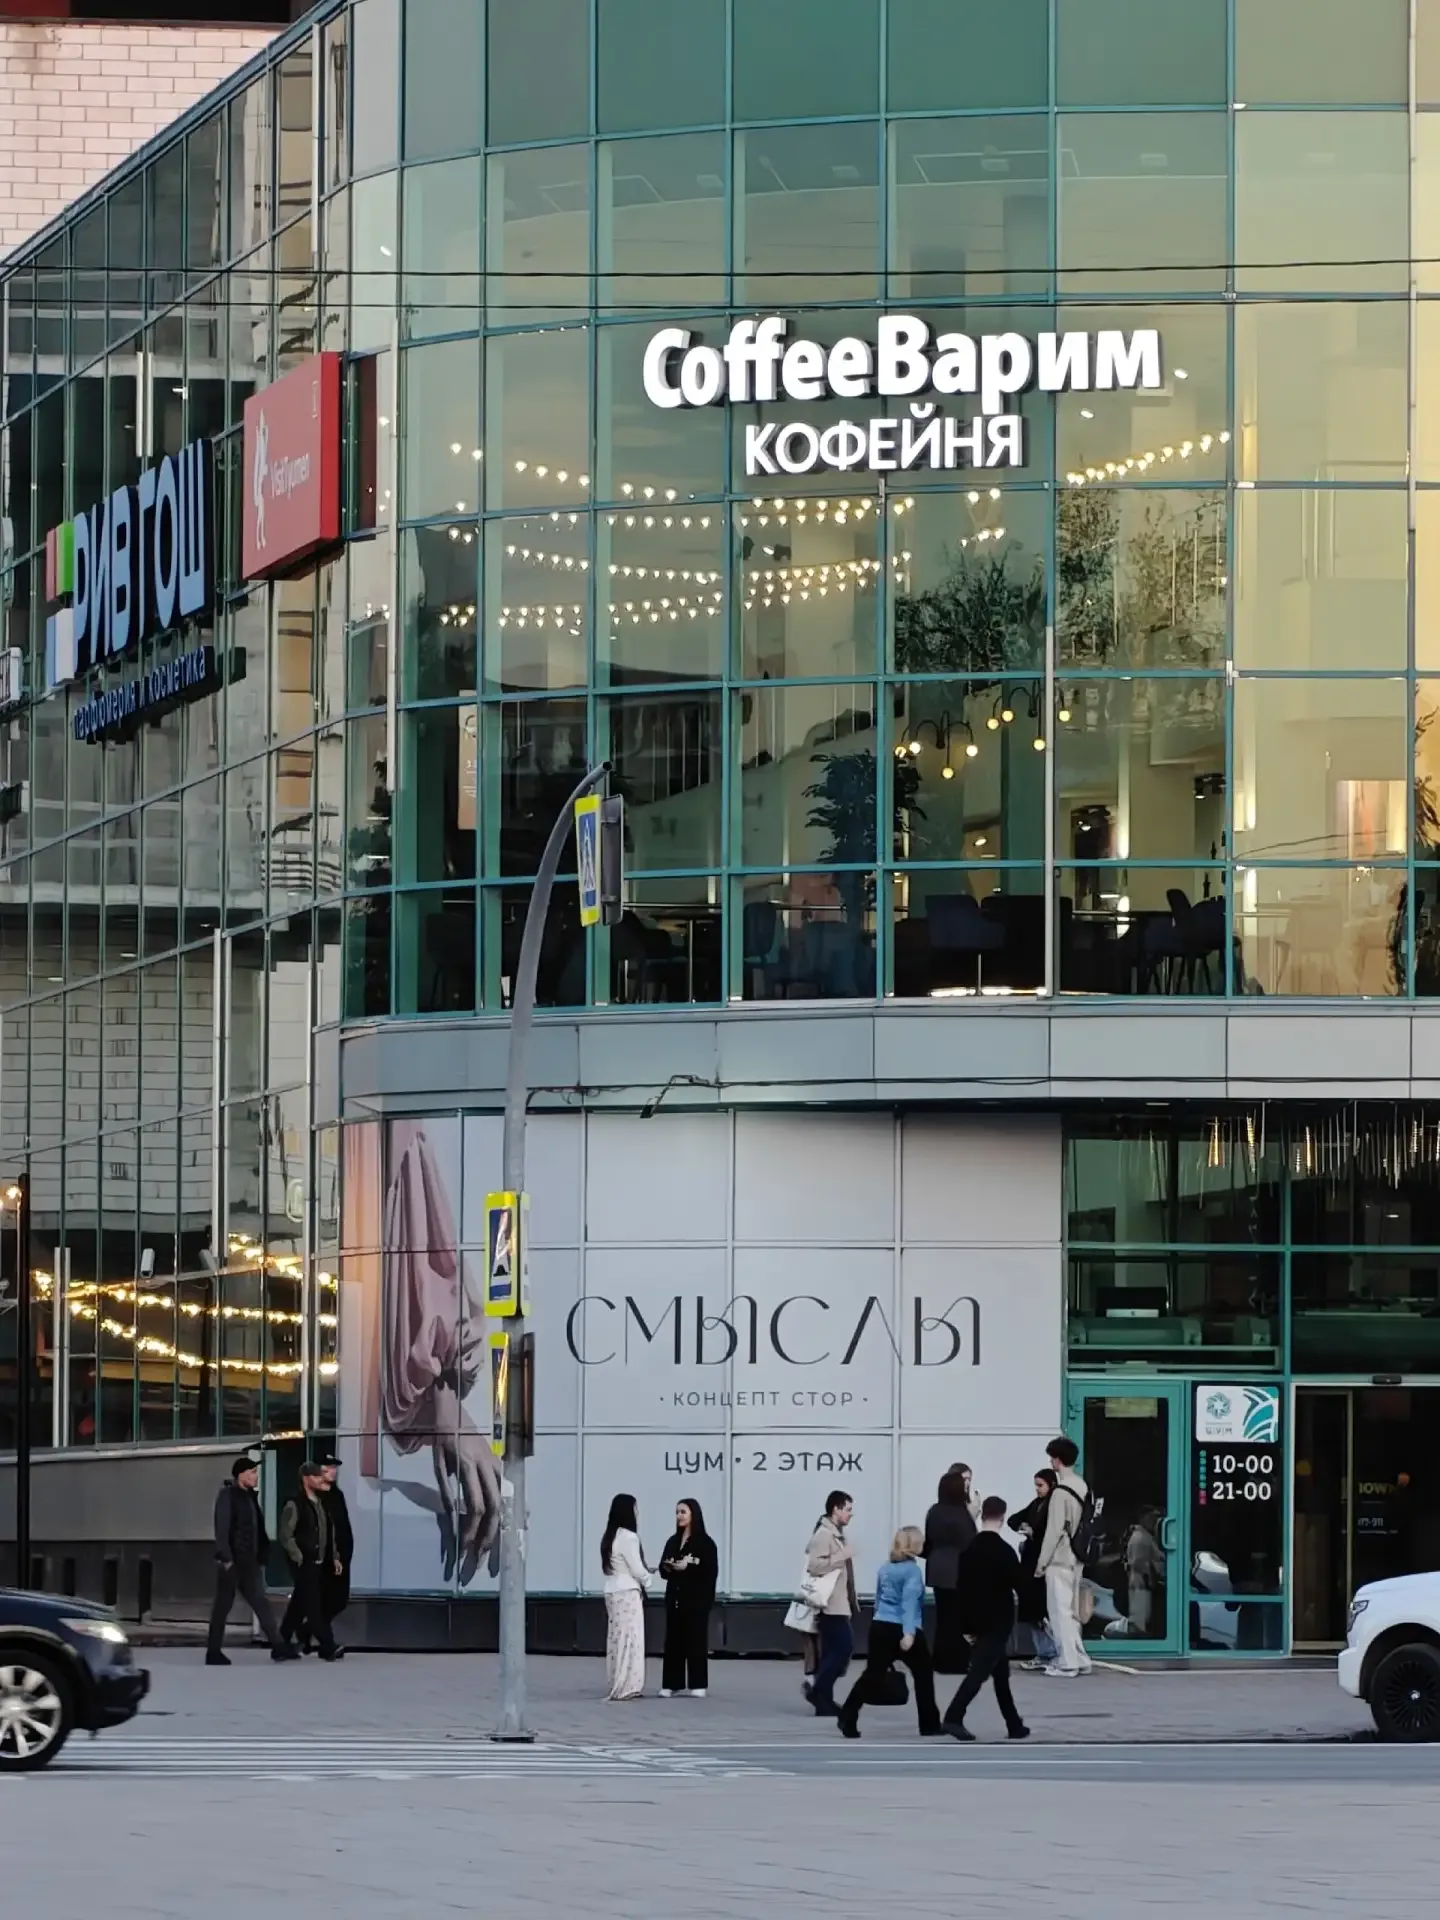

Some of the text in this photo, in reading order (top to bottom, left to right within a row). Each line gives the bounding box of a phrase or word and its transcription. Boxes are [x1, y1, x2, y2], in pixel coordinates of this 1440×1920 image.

[643, 315, 1161, 414] CoffeeВарим
[745, 402, 1024, 476] КОФЕЙНЯ
[149, 645, 206, 704] косметика
[566, 1295, 982, 1367] СМЫСЛЫ
[673, 1391, 854, 1408] КОНЦЕПТ СТОР
[664, 1451, 864, 1475] ЦУМ 2 ЭТАЖ
[1212, 1454, 1274, 1474] 10-00
[1211, 1481, 1273, 1501] 21-00
